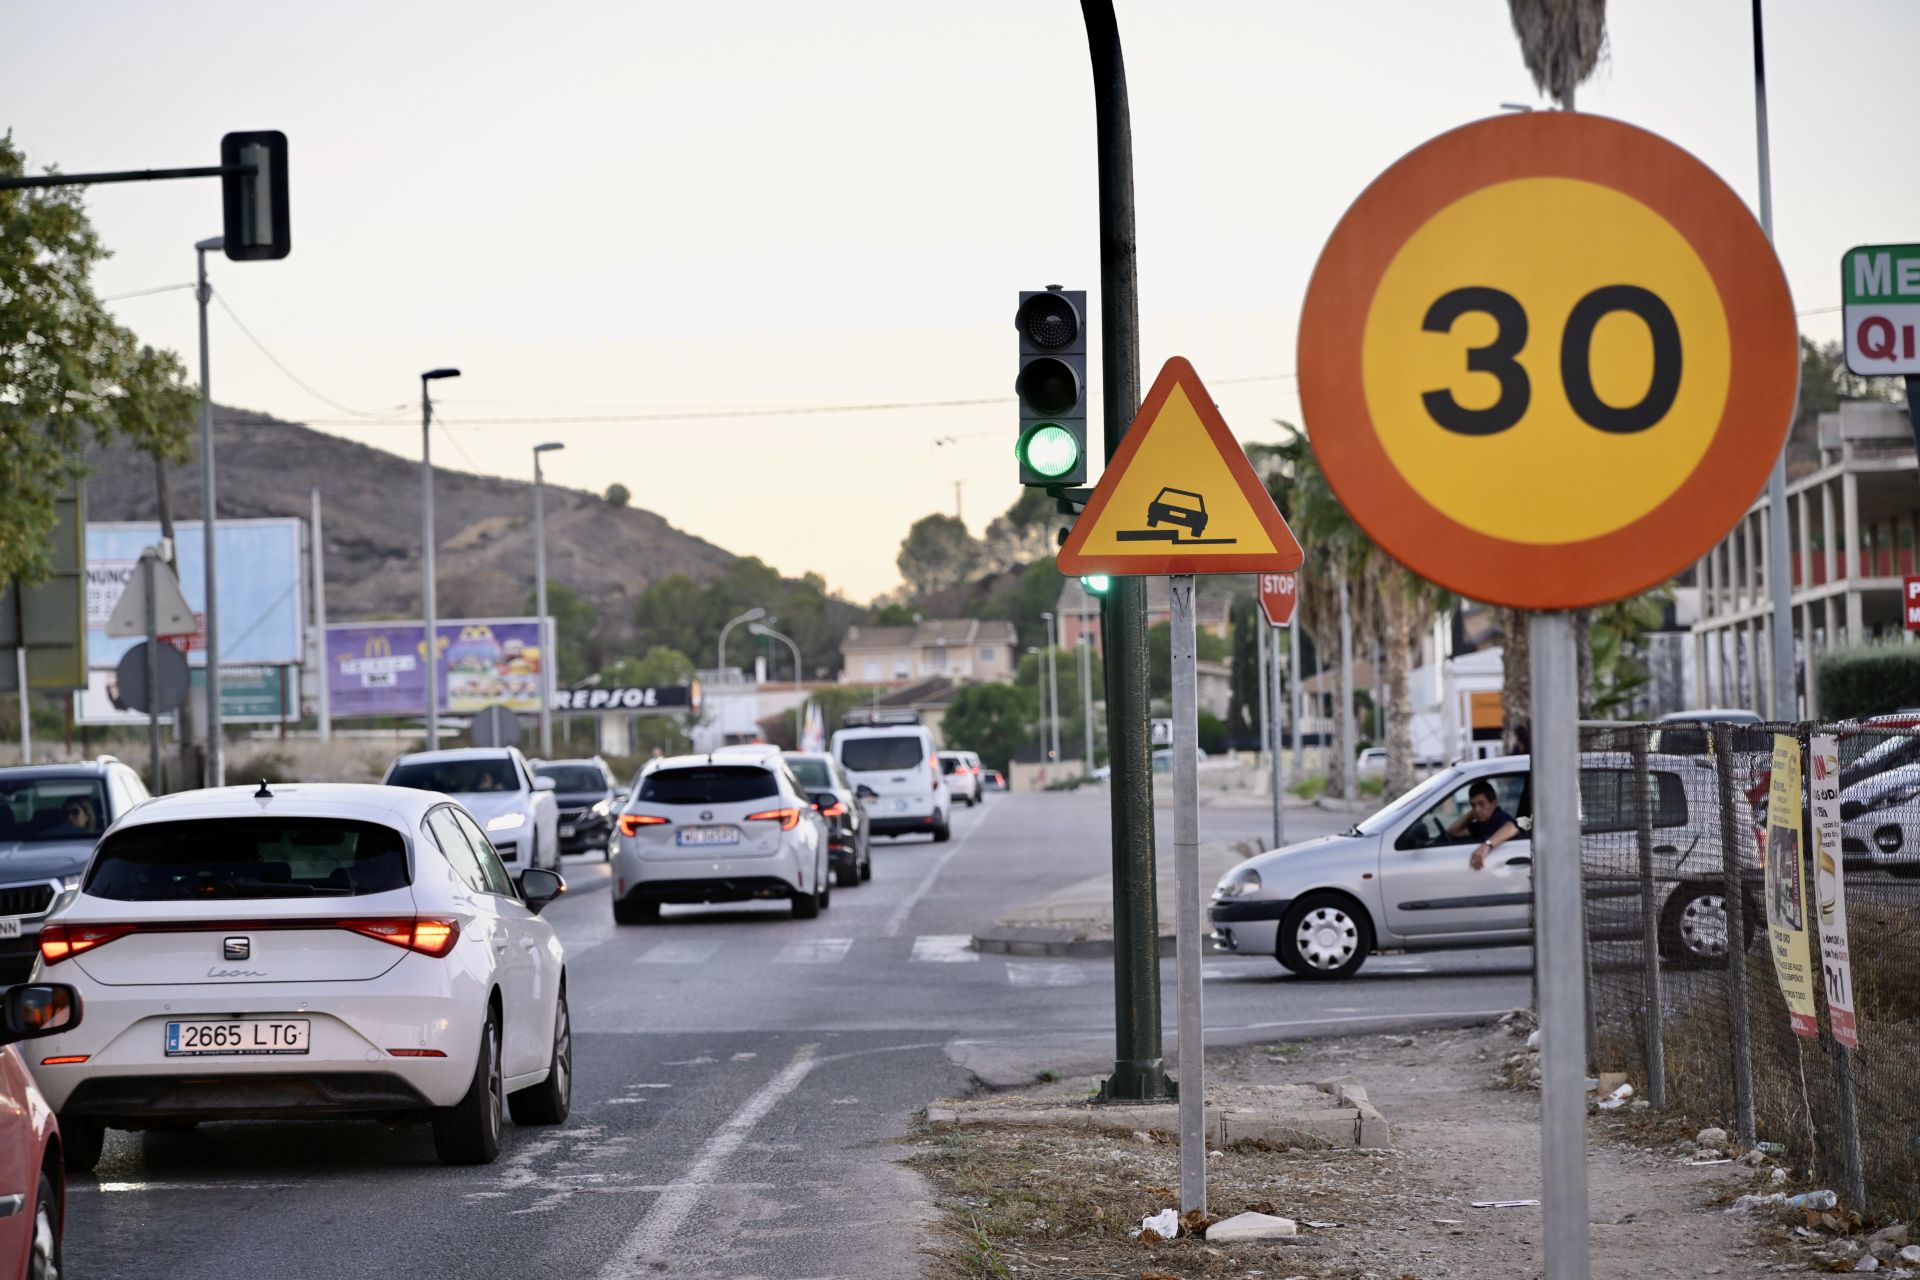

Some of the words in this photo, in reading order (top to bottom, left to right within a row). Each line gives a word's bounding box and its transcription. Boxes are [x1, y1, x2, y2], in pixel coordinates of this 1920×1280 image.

[1420, 284, 1682, 436] 30
[1264, 575, 1294, 595] STOP
[552, 687, 658, 711] REPSOL
[206, 966, 267, 978] Leon
[184, 1025, 242, 1048] 2665
[254, 1024, 297, 1046] LTG
